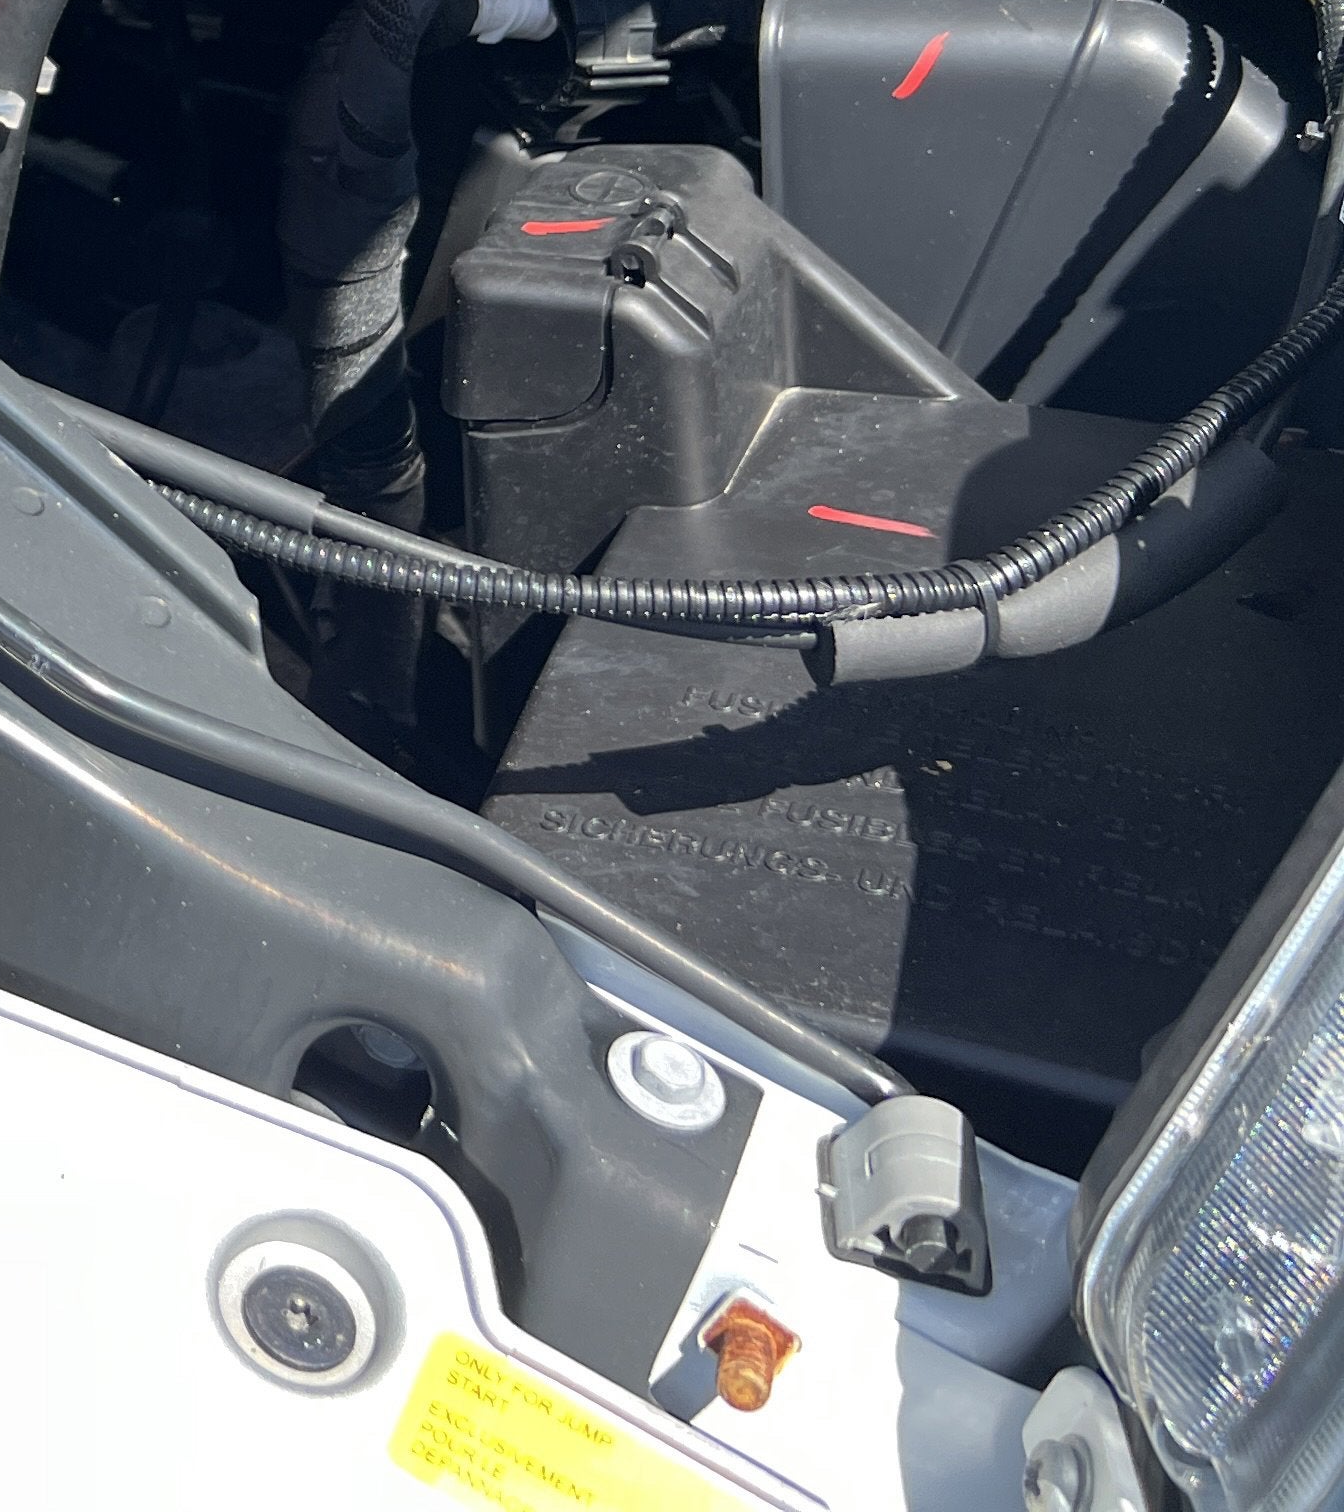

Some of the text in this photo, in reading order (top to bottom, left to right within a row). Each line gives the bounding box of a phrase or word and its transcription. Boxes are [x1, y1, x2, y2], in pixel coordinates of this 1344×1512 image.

[447, 1368, 510, 1410] START
[455, 1350, 614, 1447] ONLY FOR JUMP
